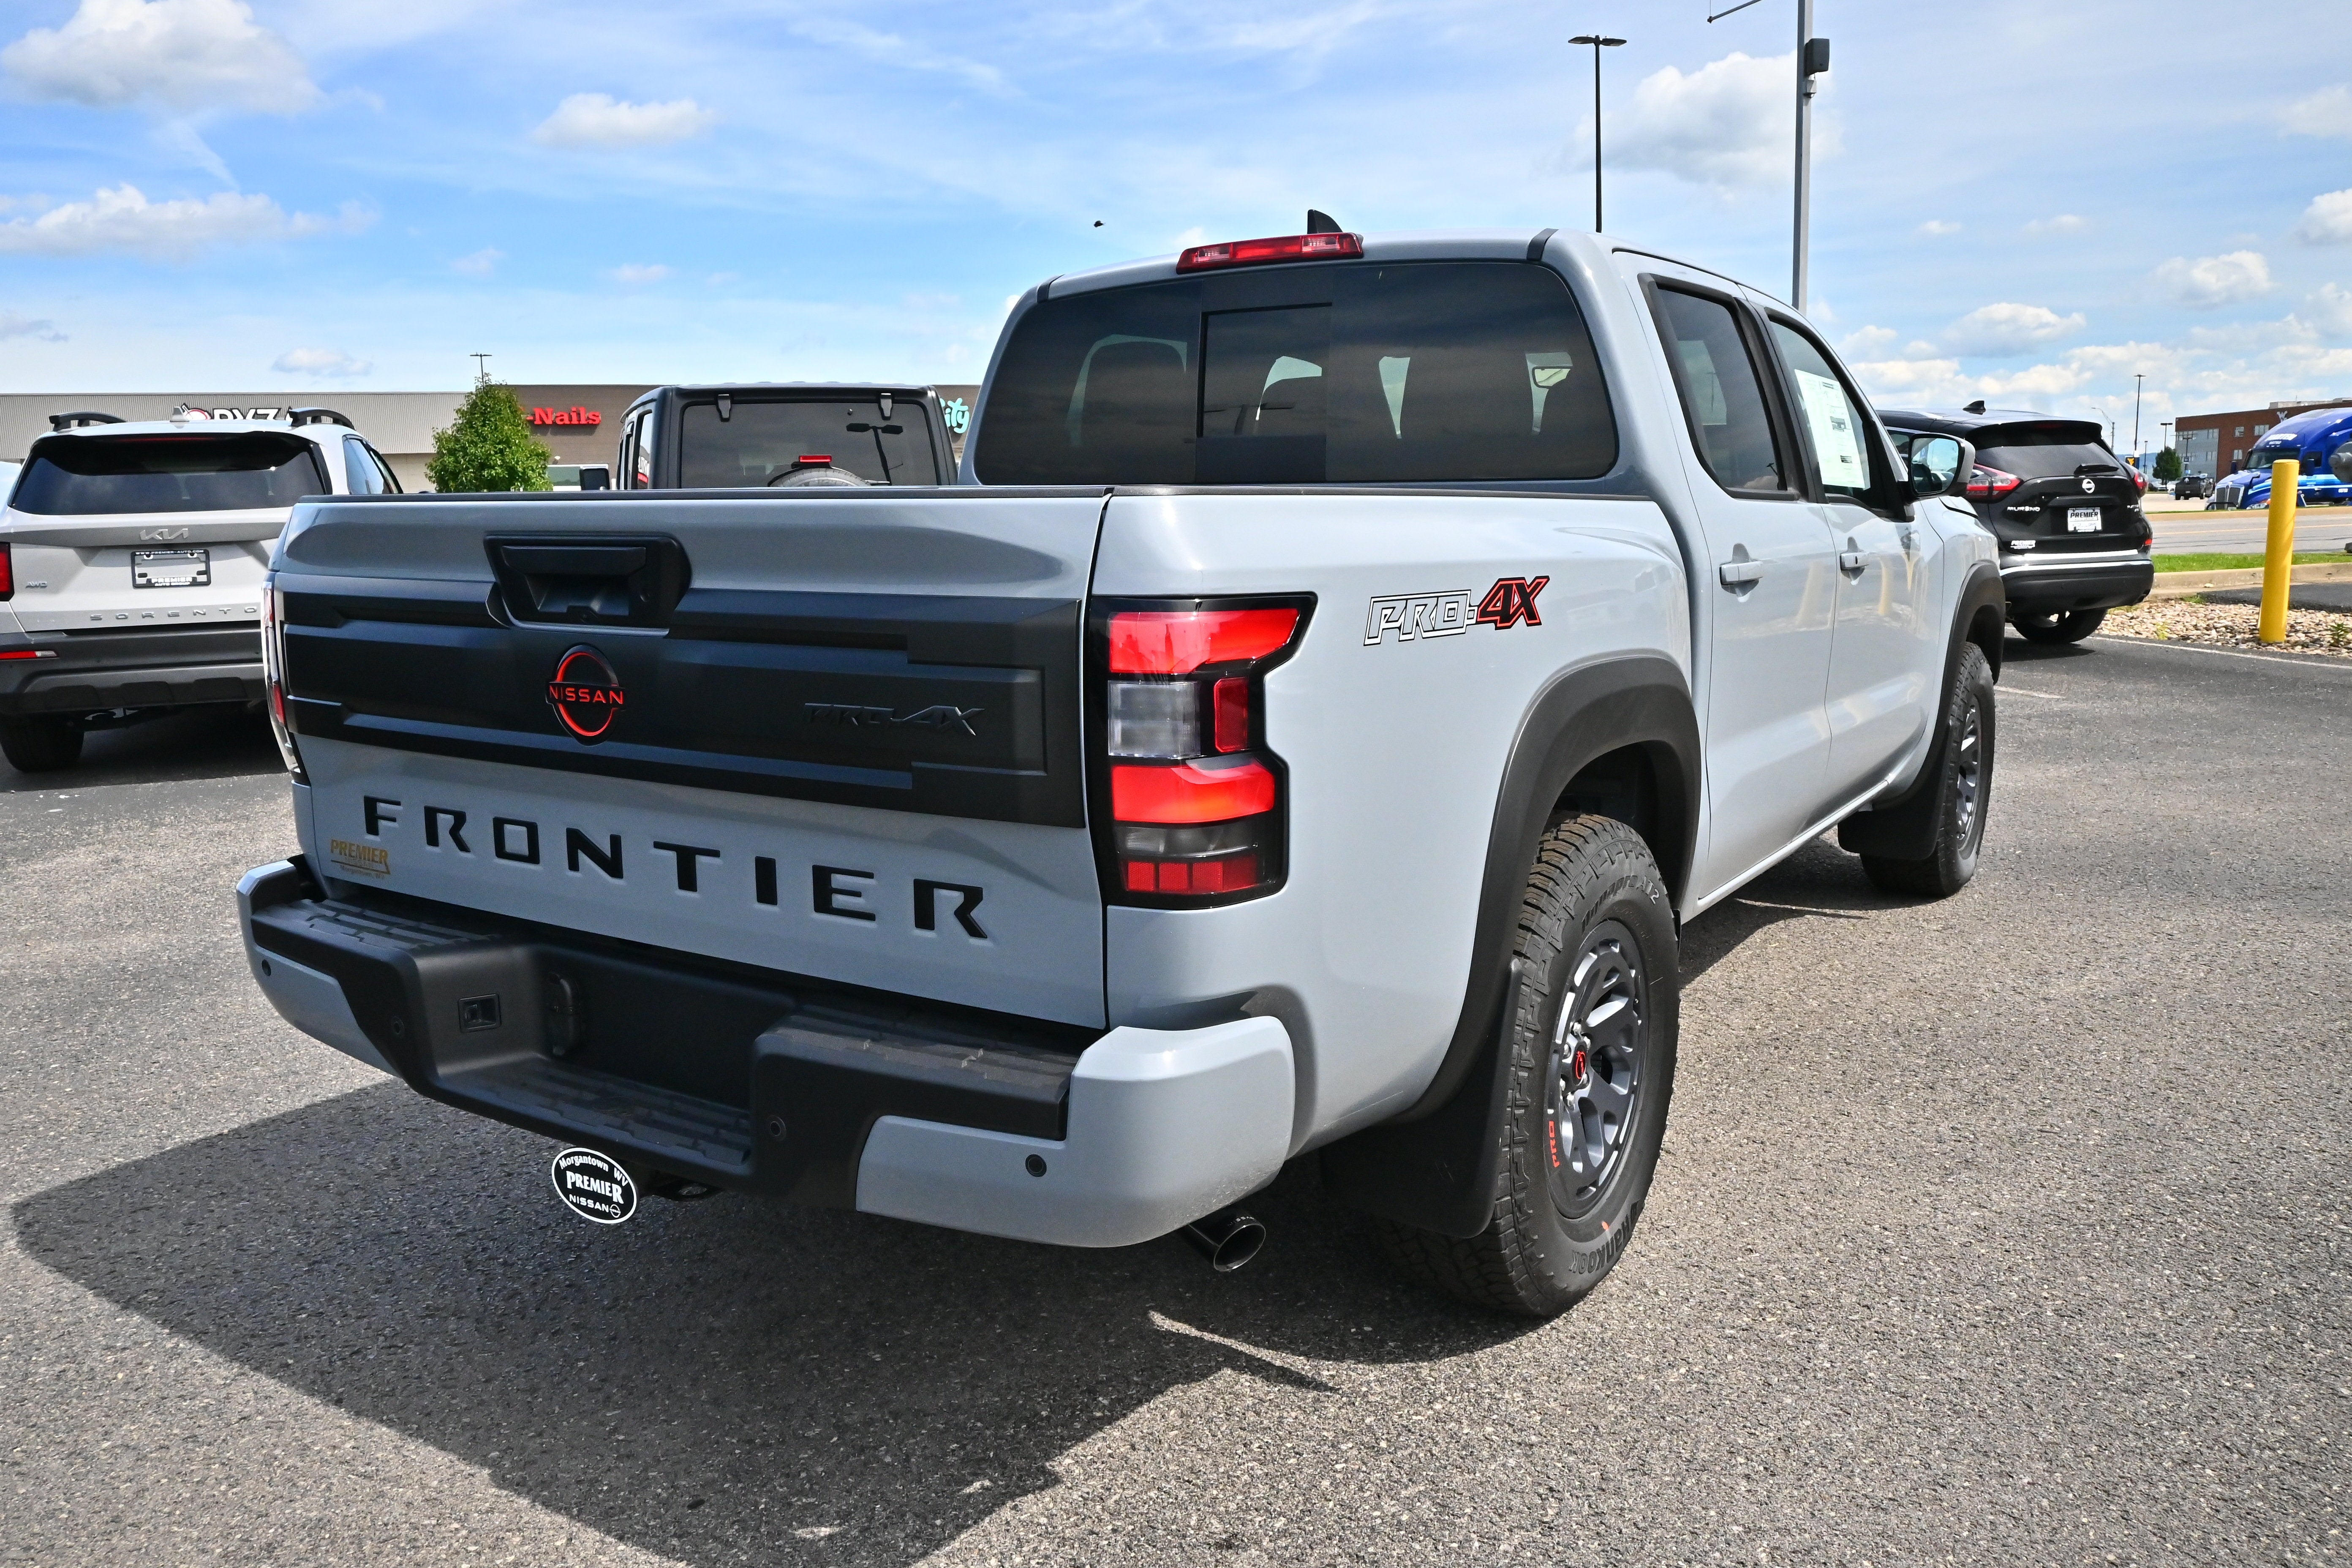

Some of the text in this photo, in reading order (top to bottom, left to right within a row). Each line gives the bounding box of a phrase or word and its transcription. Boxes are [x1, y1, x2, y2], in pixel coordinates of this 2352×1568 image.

[940, 398, 969, 434] ity
[90, 606, 257, 621] SORENTO
[550, 685, 624, 705] NISSAN
[331, 839, 389, 865] PREMIER
[363, 795, 988, 939] FRONTIER
[558, 1155, 629, 1187] Morgantown WV
[566, 1171, 624, 1204] PREMIER
[569, 1194, 609, 1213] NISSAN
